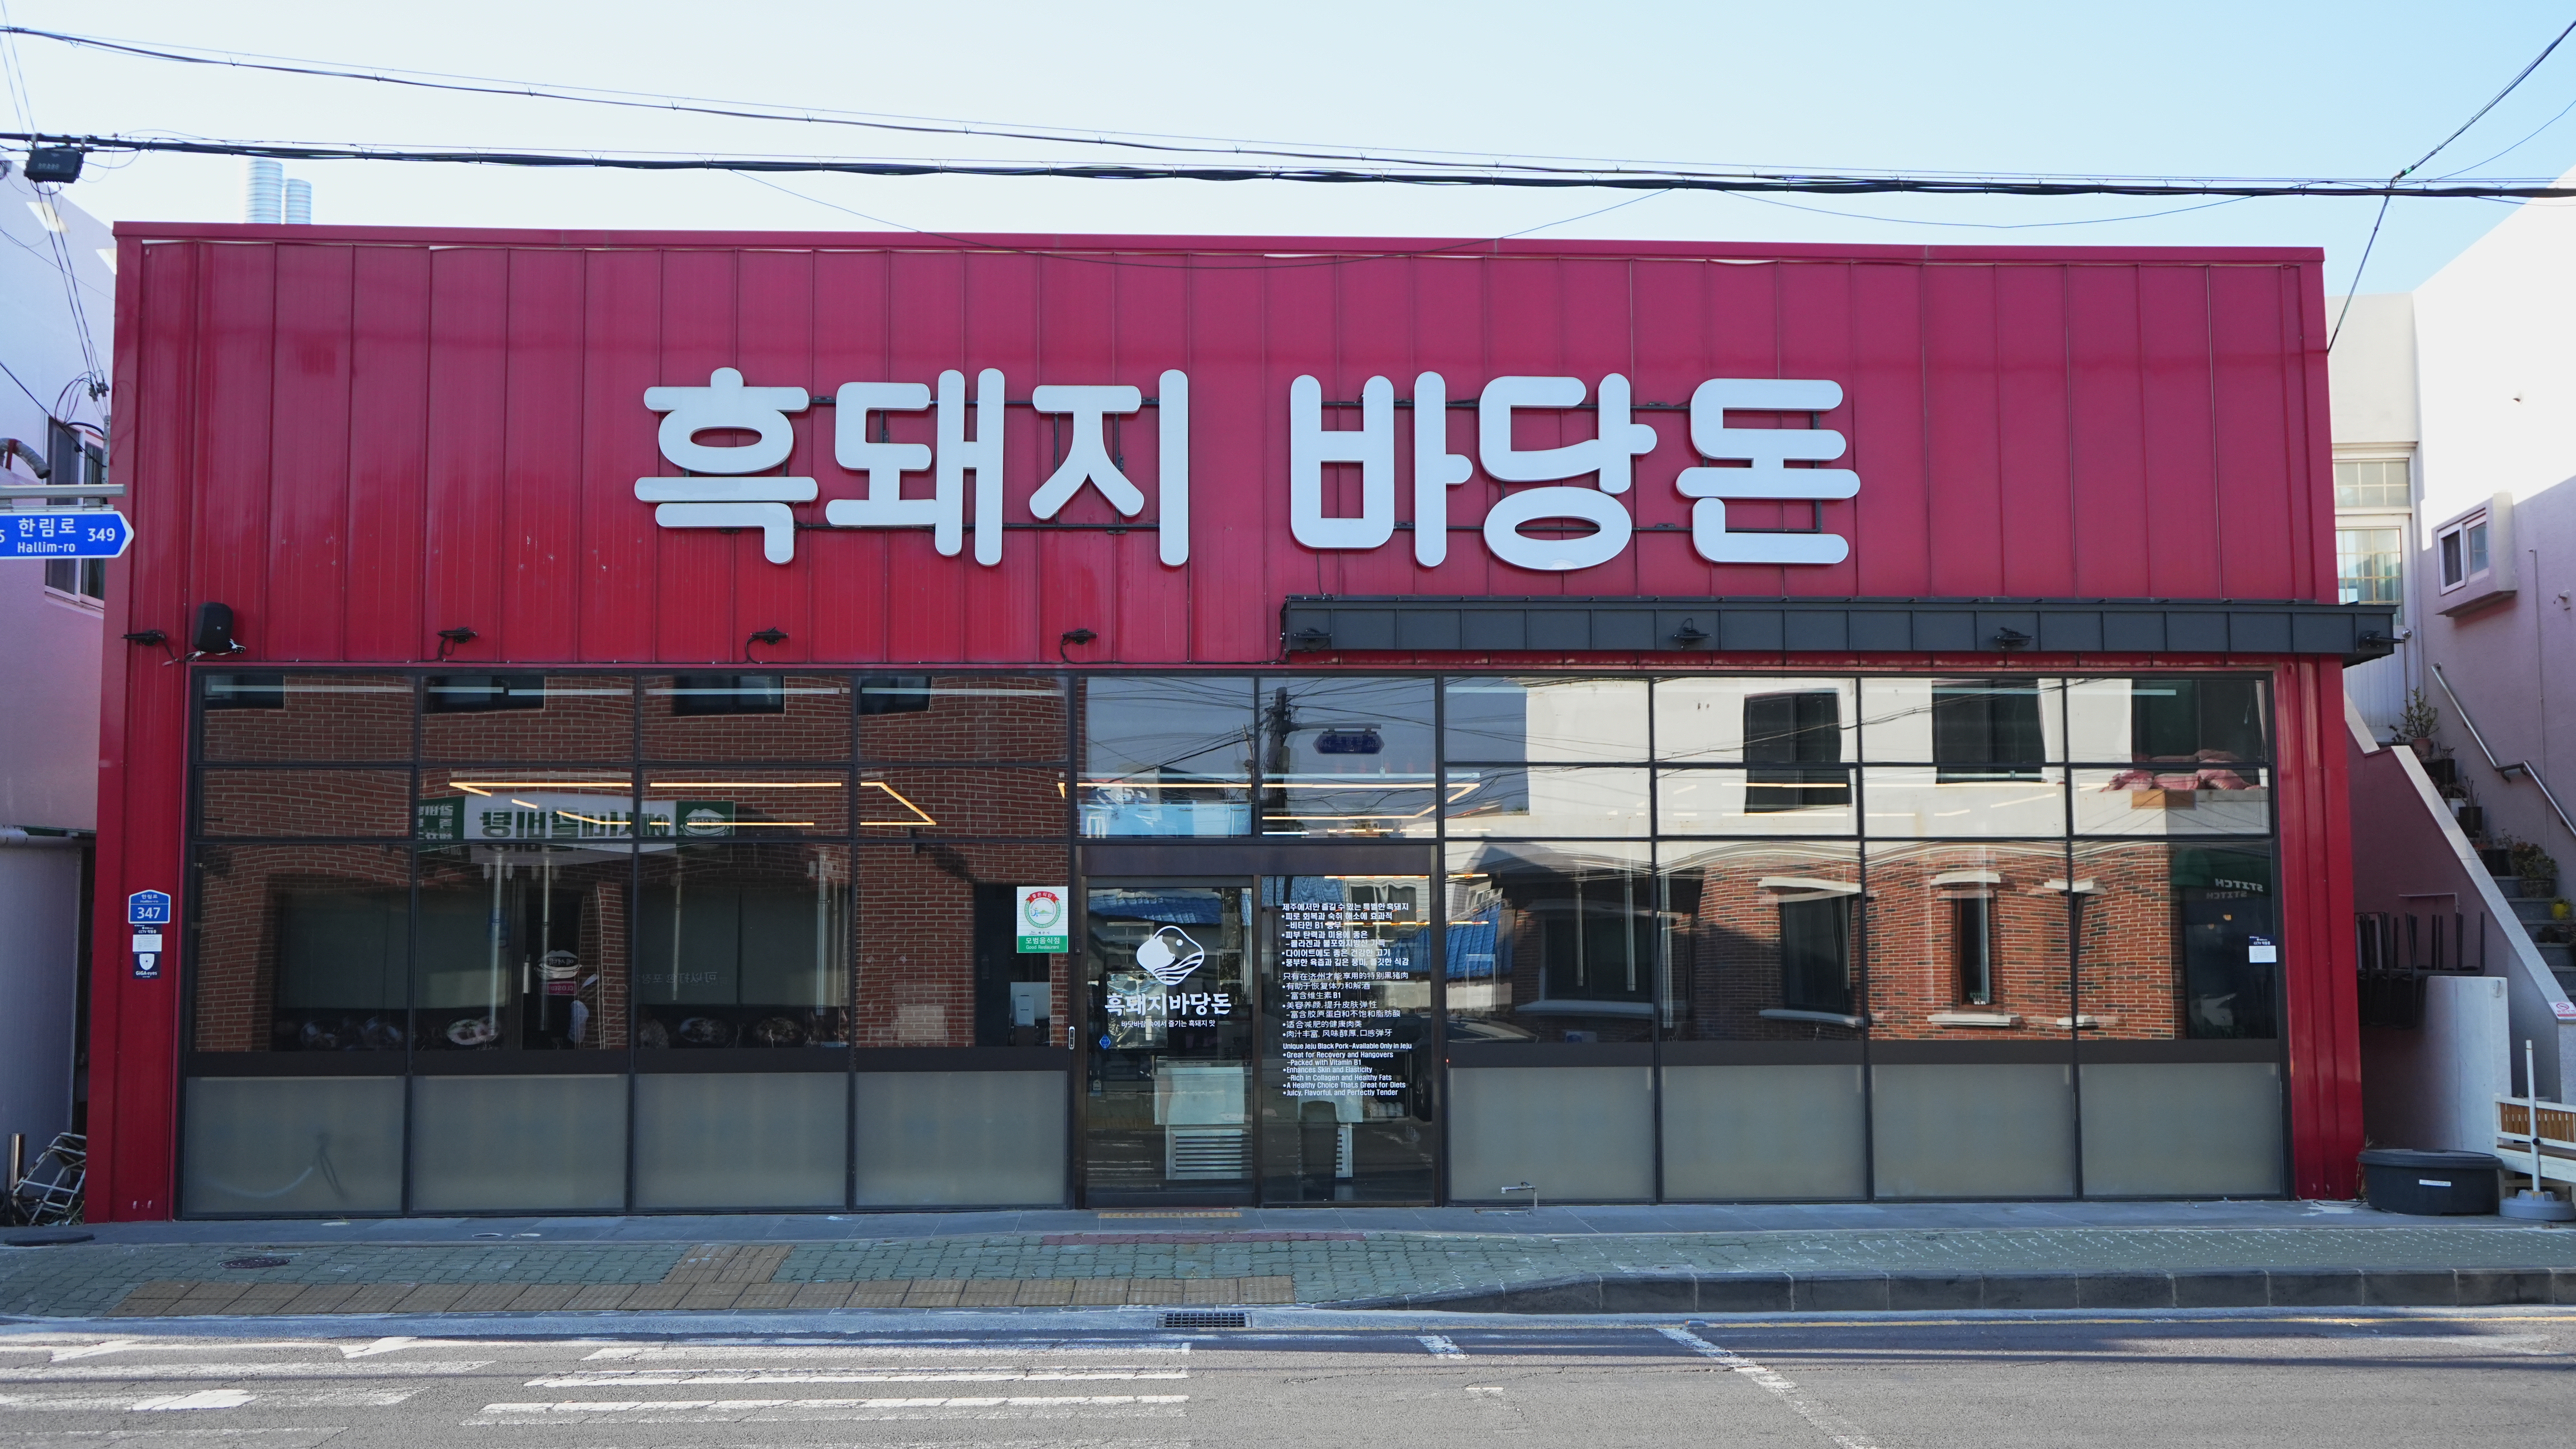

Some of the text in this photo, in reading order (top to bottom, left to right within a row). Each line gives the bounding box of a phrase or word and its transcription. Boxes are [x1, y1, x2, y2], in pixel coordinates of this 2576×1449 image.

[634, 367, 1860, 571] 흑돼지 바당돈
[18, 518, 76, 537] 한림로
[87, 528, 116, 542] 349
[17, 542, 75, 553] Hallim-ro
[137, 907, 160, 918] 347
[1283, 972, 1408, 981] 只有在济州才能享用的特别黑猪肉
[1104, 992, 1232, 1016] 흑돼지바당돈
